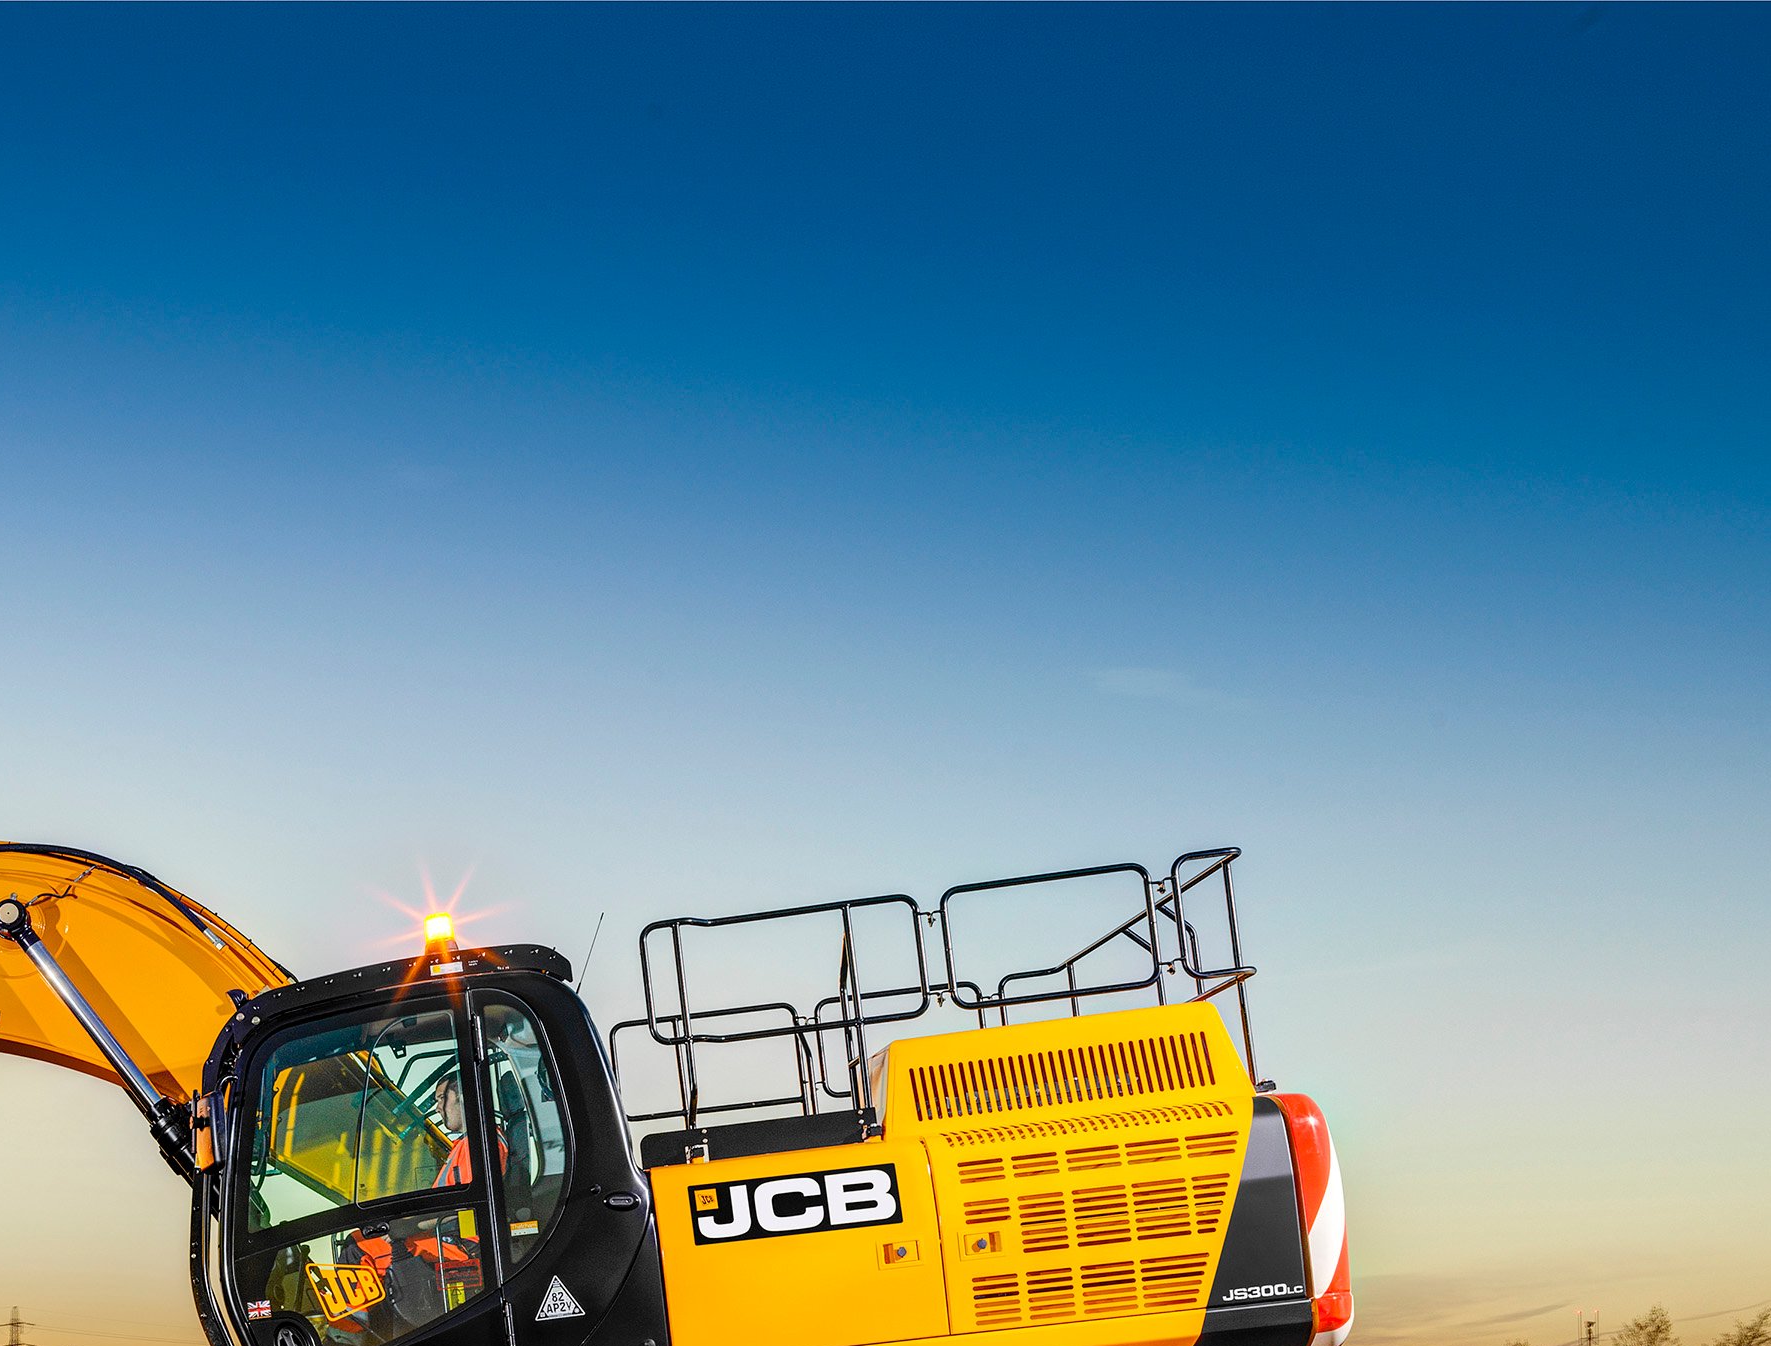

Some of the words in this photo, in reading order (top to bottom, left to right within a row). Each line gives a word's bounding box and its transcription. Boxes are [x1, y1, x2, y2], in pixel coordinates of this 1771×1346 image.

[697, 1169, 897, 1239] JCB
[319, 1269, 380, 1314] JCB
[551, 1291, 565, 1303] 82
[546, 1300, 572, 1314] AP2Y
